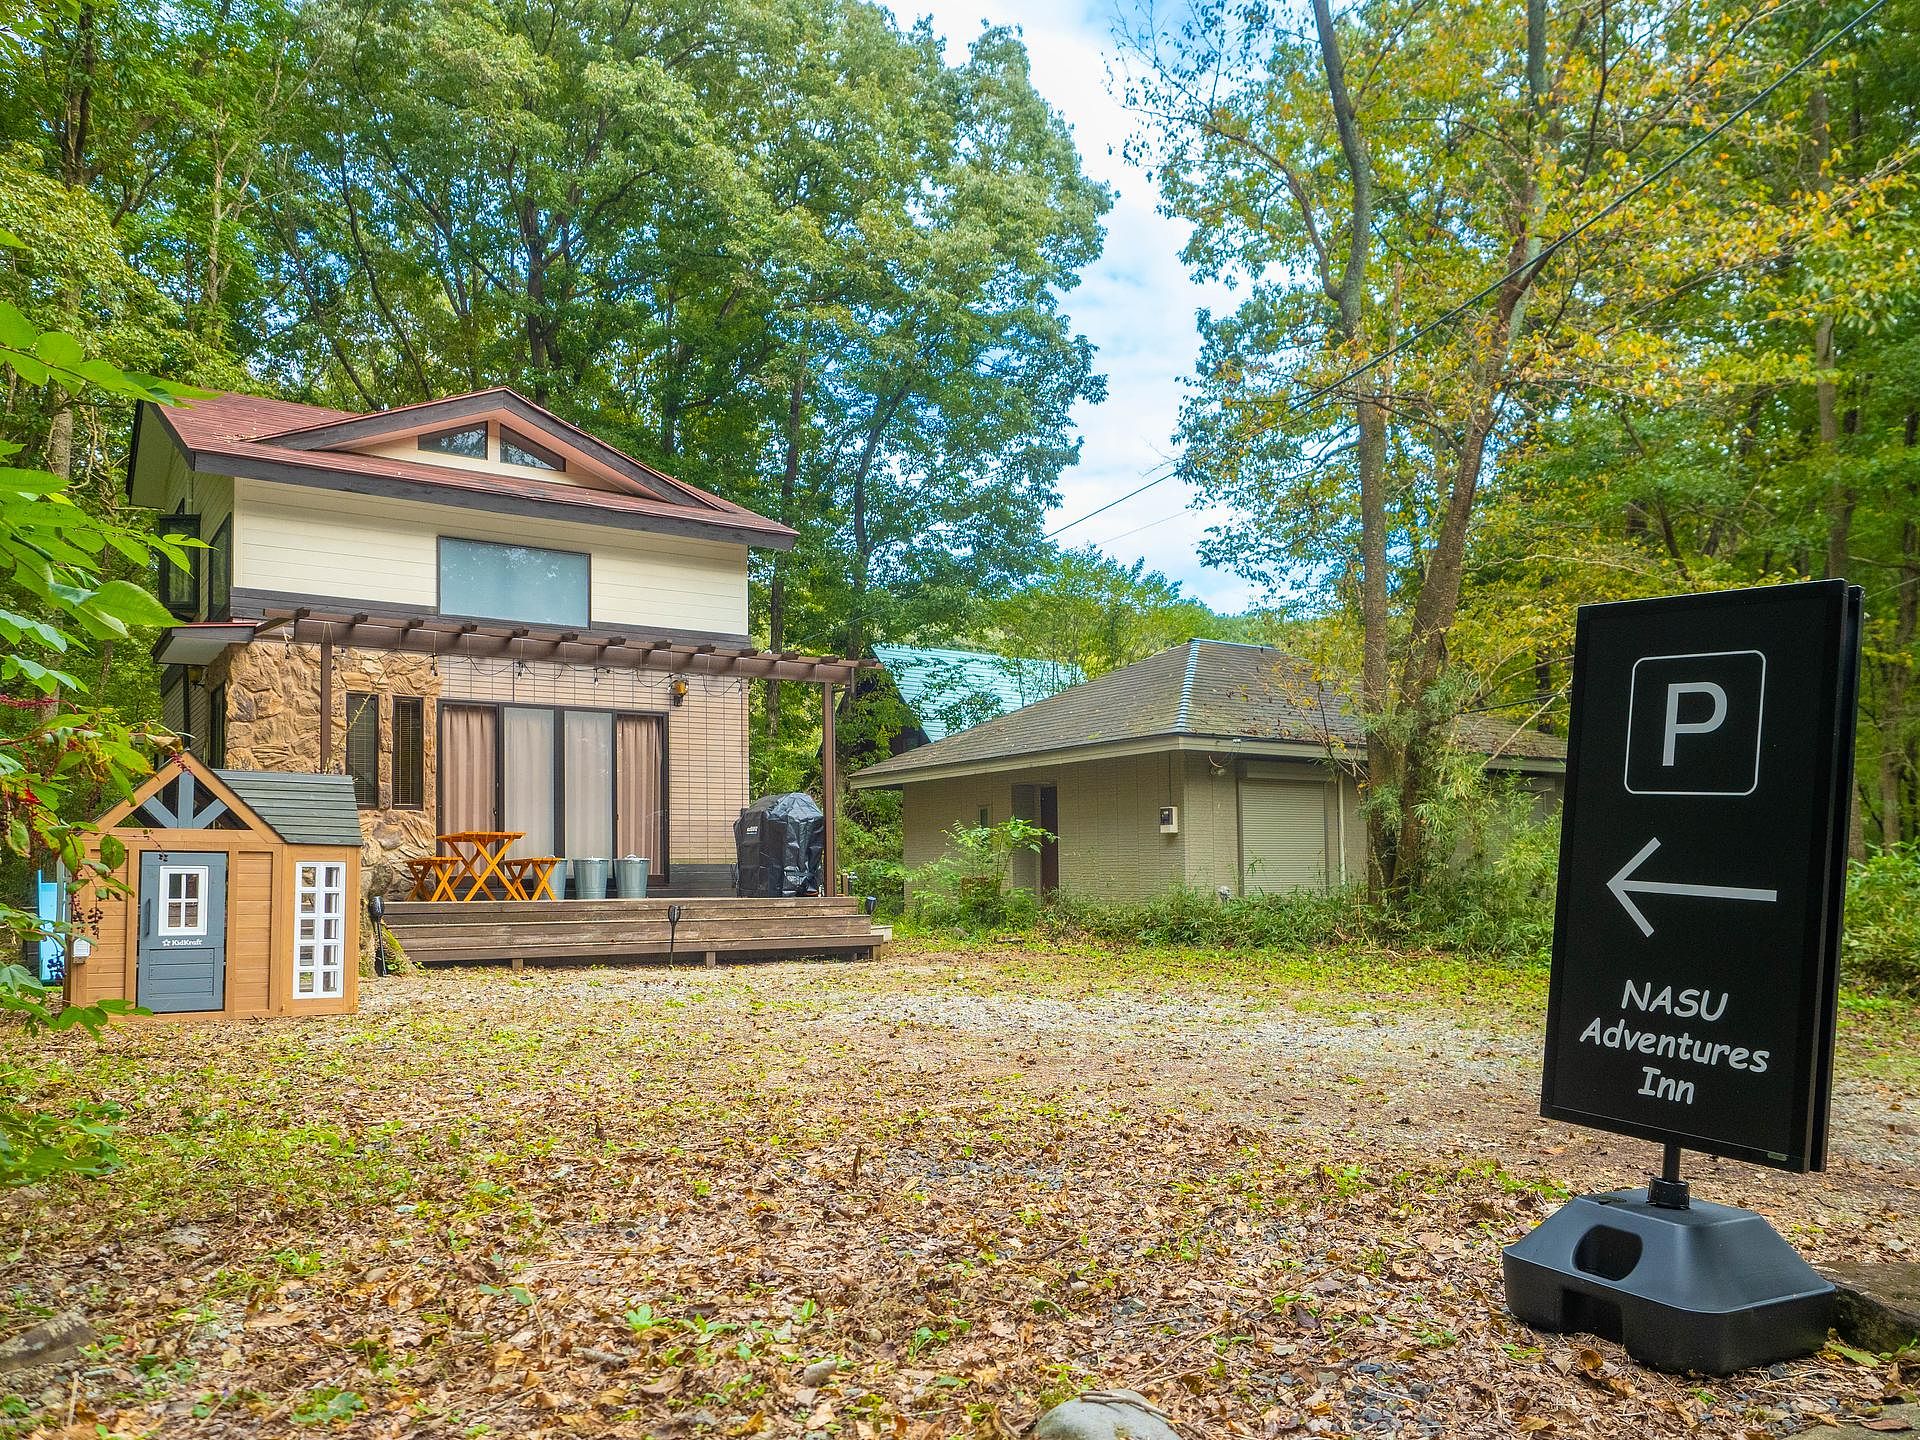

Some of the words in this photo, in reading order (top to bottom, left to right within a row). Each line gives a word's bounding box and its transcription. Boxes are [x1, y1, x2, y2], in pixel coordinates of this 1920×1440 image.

[1662, 682, 1728, 767] P
[1621, 979, 1729, 1022] NASU
[1579, 1017, 1770, 1073] Adventures
[1637, 1066, 1695, 1105] Inn
